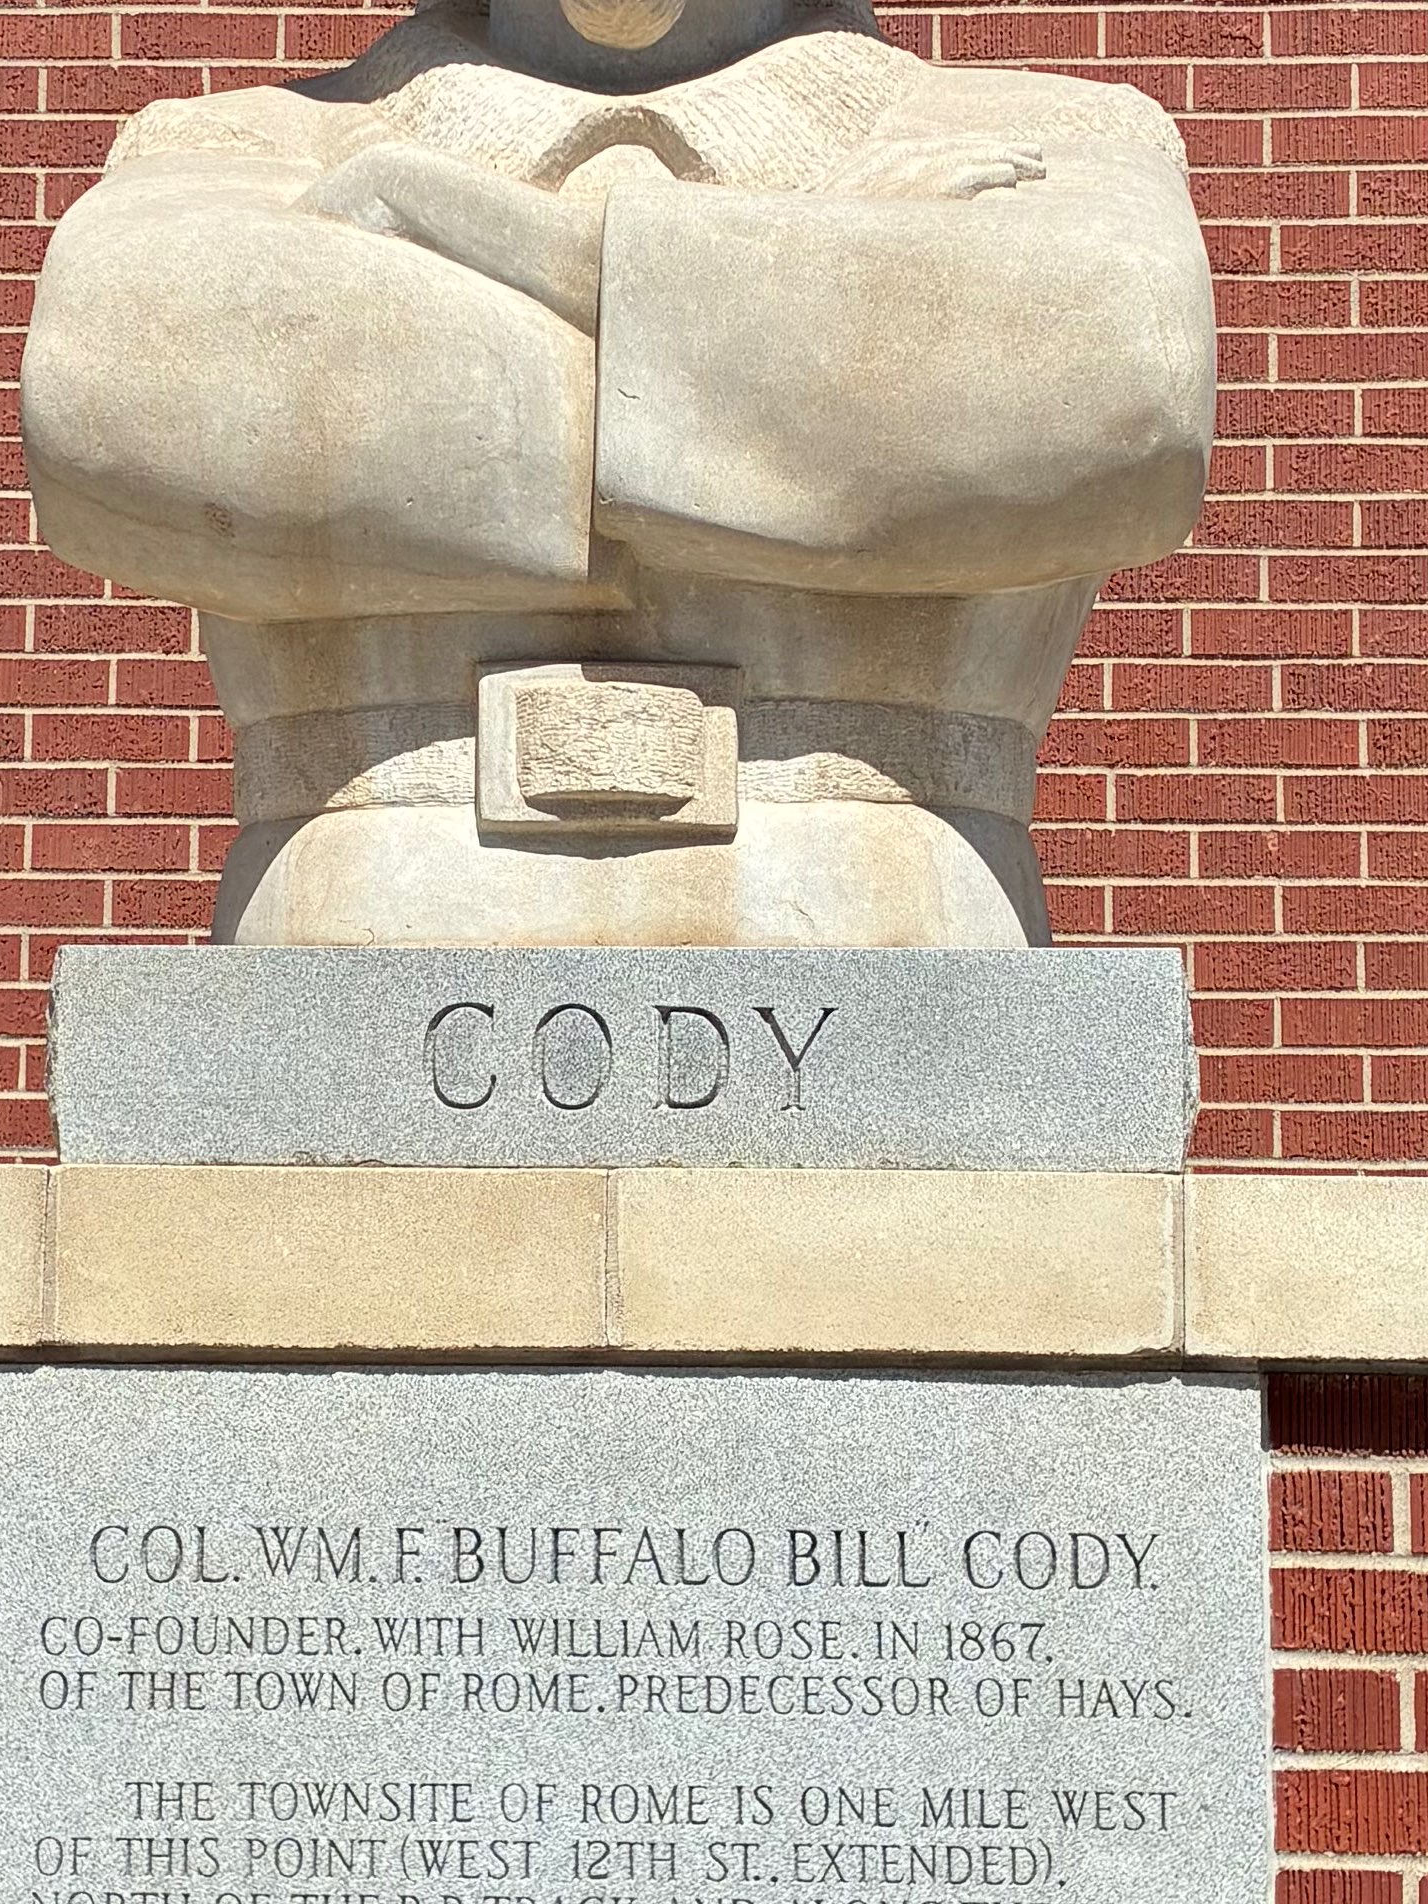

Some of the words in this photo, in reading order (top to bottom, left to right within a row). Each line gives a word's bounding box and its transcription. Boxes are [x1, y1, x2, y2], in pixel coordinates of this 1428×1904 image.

[423, 1001, 838, 1113] CODY
[90, 1525, 241, 1584] COL.
[256, 1526, 377, 1584] WM.
[373, 1617, 483, 1657] WITH
[509, 1617, 700, 1660] WILLIAM
[874, 1620, 919, 1661] IN
[39, 1671, 96, 1711] OF
[118, 1671, 206, 1711] THE
[226, 1671, 357, 1712] TOWN
[382, 1672, 440, 1712] OF
[618, 1674, 950, 1716] PREDECESSOR
[976, 1677, 1032, 1717] OF
[1058, 1678, 1193, 1720] HAYS.
[126, 1782, 216, 1822] THE
[241, 1782, 473, 1823] TOWNSITE
[499, 1783, 557, 1823] OF
[580, 1784, 710, 1825] ROME
[735, 1785, 774, 1826] IS
[800, 1785, 897, 1828] ONE
[921, 1788, 1029, 1829] MILE
[1052, 1790, 1178, 1831] WEST
[35, 1836, 92, 1877] OF
[116, 1837, 219, 1877] THIS
[244, 1837, 386, 1879] POINT
[401, 1834, 540, 1882] (WEST
[572, 1840, 675, 1881] 12TH
